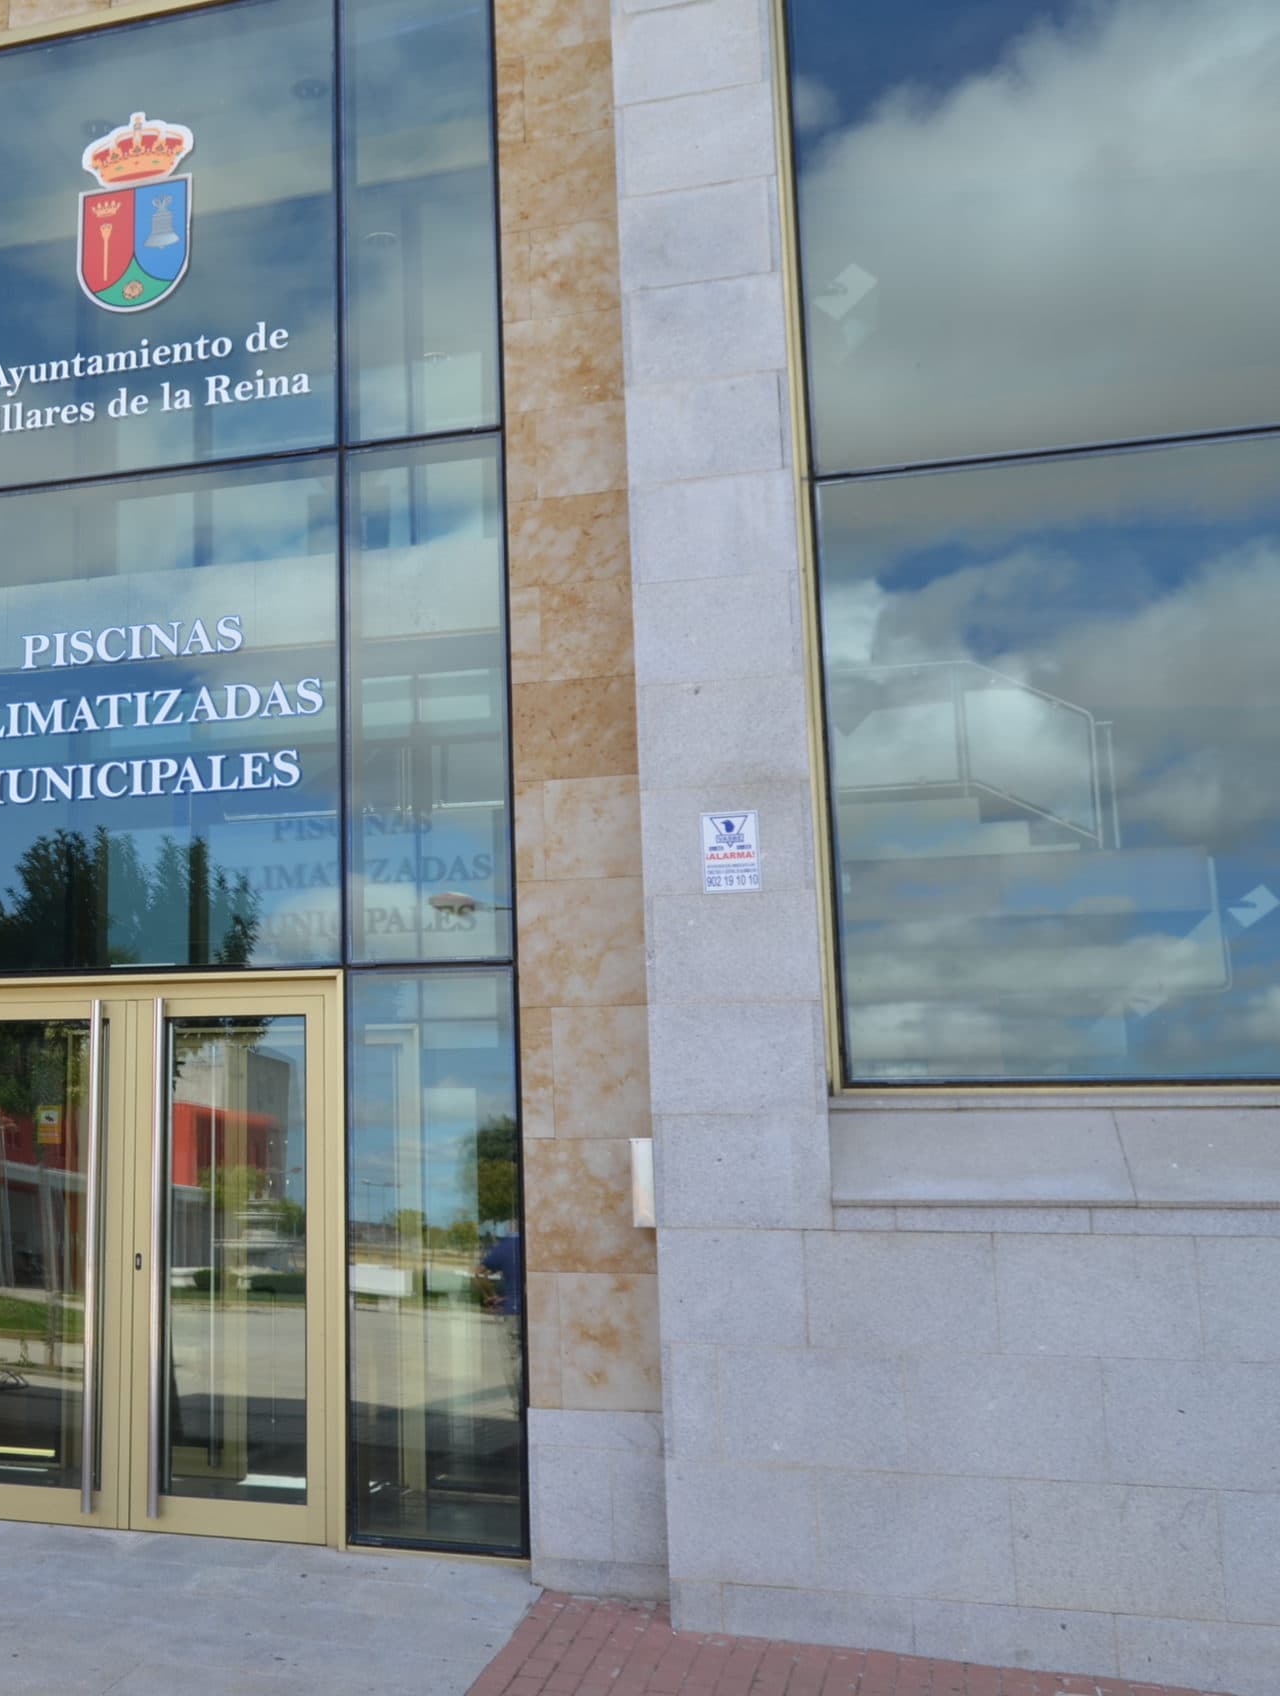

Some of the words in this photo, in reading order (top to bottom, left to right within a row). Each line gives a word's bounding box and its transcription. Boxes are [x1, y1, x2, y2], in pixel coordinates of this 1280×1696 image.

[245, 321, 290, 354] de
[107, 387, 149, 419] de
[160, 382, 193, 412] la
[204, 367, 312, 407] Reina
[21, 615, 244, 671] PISCINAS
